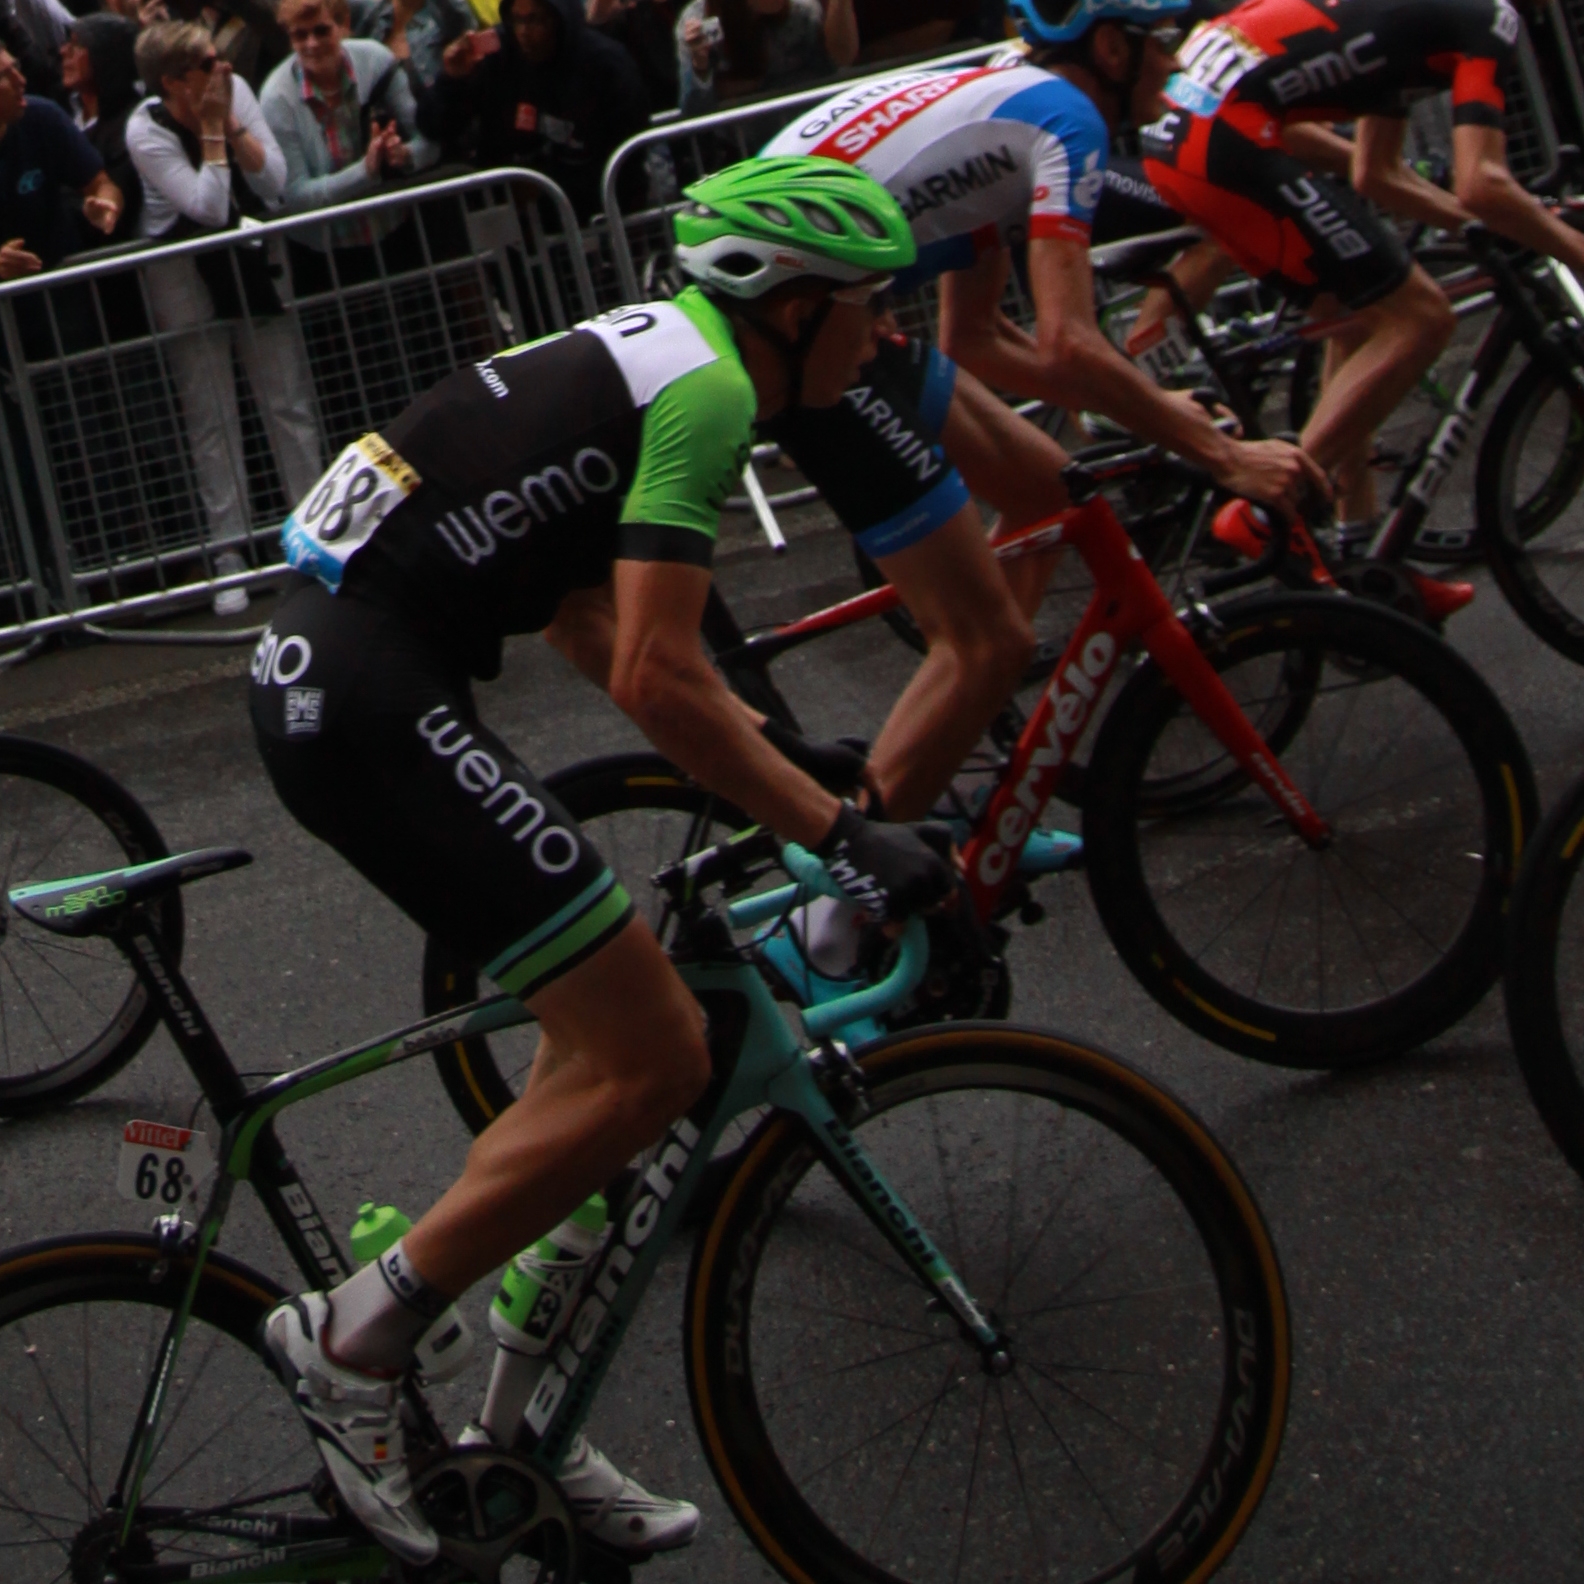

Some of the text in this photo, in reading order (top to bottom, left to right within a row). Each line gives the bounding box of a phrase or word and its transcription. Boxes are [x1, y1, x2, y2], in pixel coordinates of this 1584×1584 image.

[1268, 31, 1388, 105] BMC
[834, 76, 959, 155] SHARP
[842, 385, 942, 482] ARMIN
[304, 452, 378, 541] 68
[435, 447, 619, 566] wemo
[417, 705, 580, 874] wemo
[62, 884, 109, 904] san
[132, 933, 204, 1038] Bianchi
[126, 1123, 184, 1149] Vittel
[135, 1152, 186, 1205] 68
[277, 1182, 348, 1287] Bian
[822, 1117, 938, 1266] Bianchi
[523, 1116, 702, 1438] Bianchi
[189, 1546, 287, 1579] Bianchi
